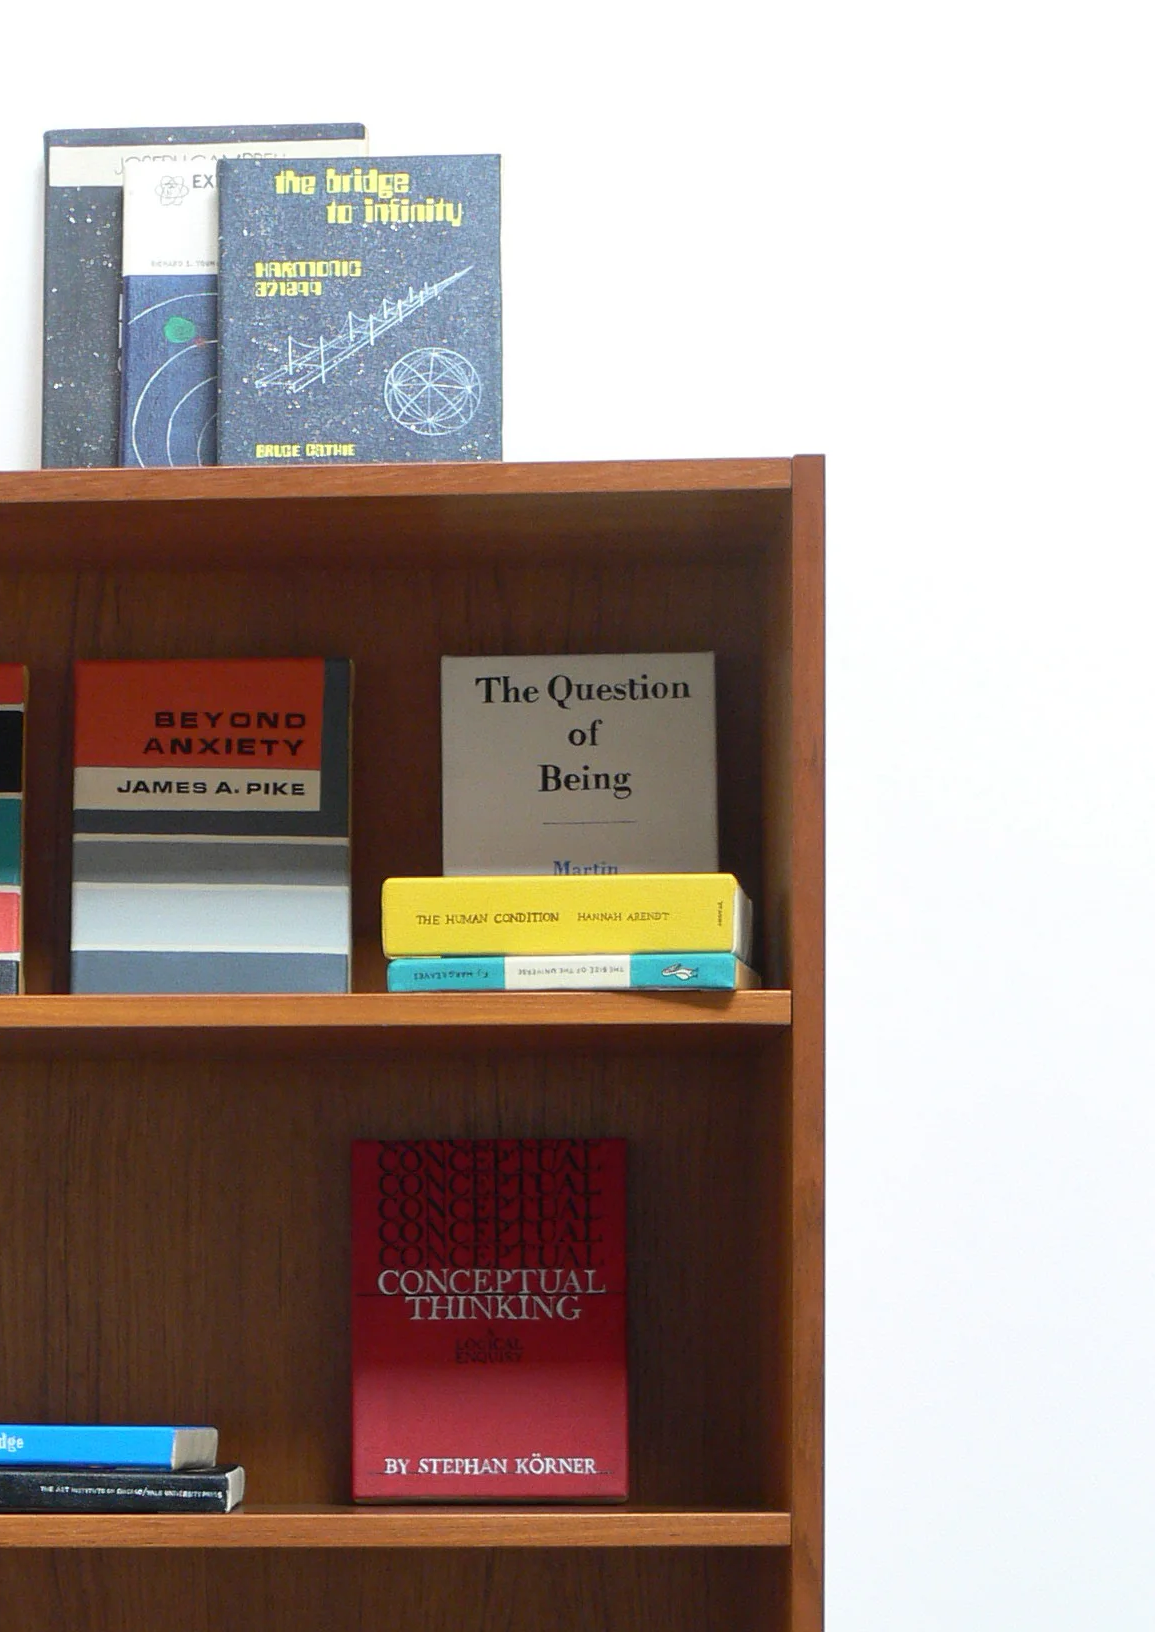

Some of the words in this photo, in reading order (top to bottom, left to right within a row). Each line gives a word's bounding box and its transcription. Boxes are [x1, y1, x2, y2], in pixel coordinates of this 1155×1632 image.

[275, 168, 317, 195] the
[325, 167, 410, 199] bridge
[326, 199, 353, 224] to
[364, 195, 463, 228] infinity
[475, 675, 541, 705] The
[546, 673, 691, 711] Question
[154, 710, 308, 730] BEYOND
[567, 718, 604, 748] of
[143, 737, 305, 757] ANXIETY
[116, 778, 208, 797] JAMES
[213, 779, 241, 796] A.
[246, 779, 307, 797] PIKE
[538, 763, 633, 801] Being
[553, 860, 619, 876] Martin
[416, 914, 441, 926] THE
[444, 912, 489, 926] HUMAN
[493, 911, 560, 925] CONDITION
[577, 911, 623, 922] HANNAH
[626, 910, 670, 922] ARENDT
[377, 1268, 606, 1296] CONCEPTUAL
[405, 1295, 582, 1322] THINKING
[383, 1458, 411, 1475] BY
[417, 1458, 508, 1475] STEPHAN
[514, 1452, 598, 1475] KÖRNER
